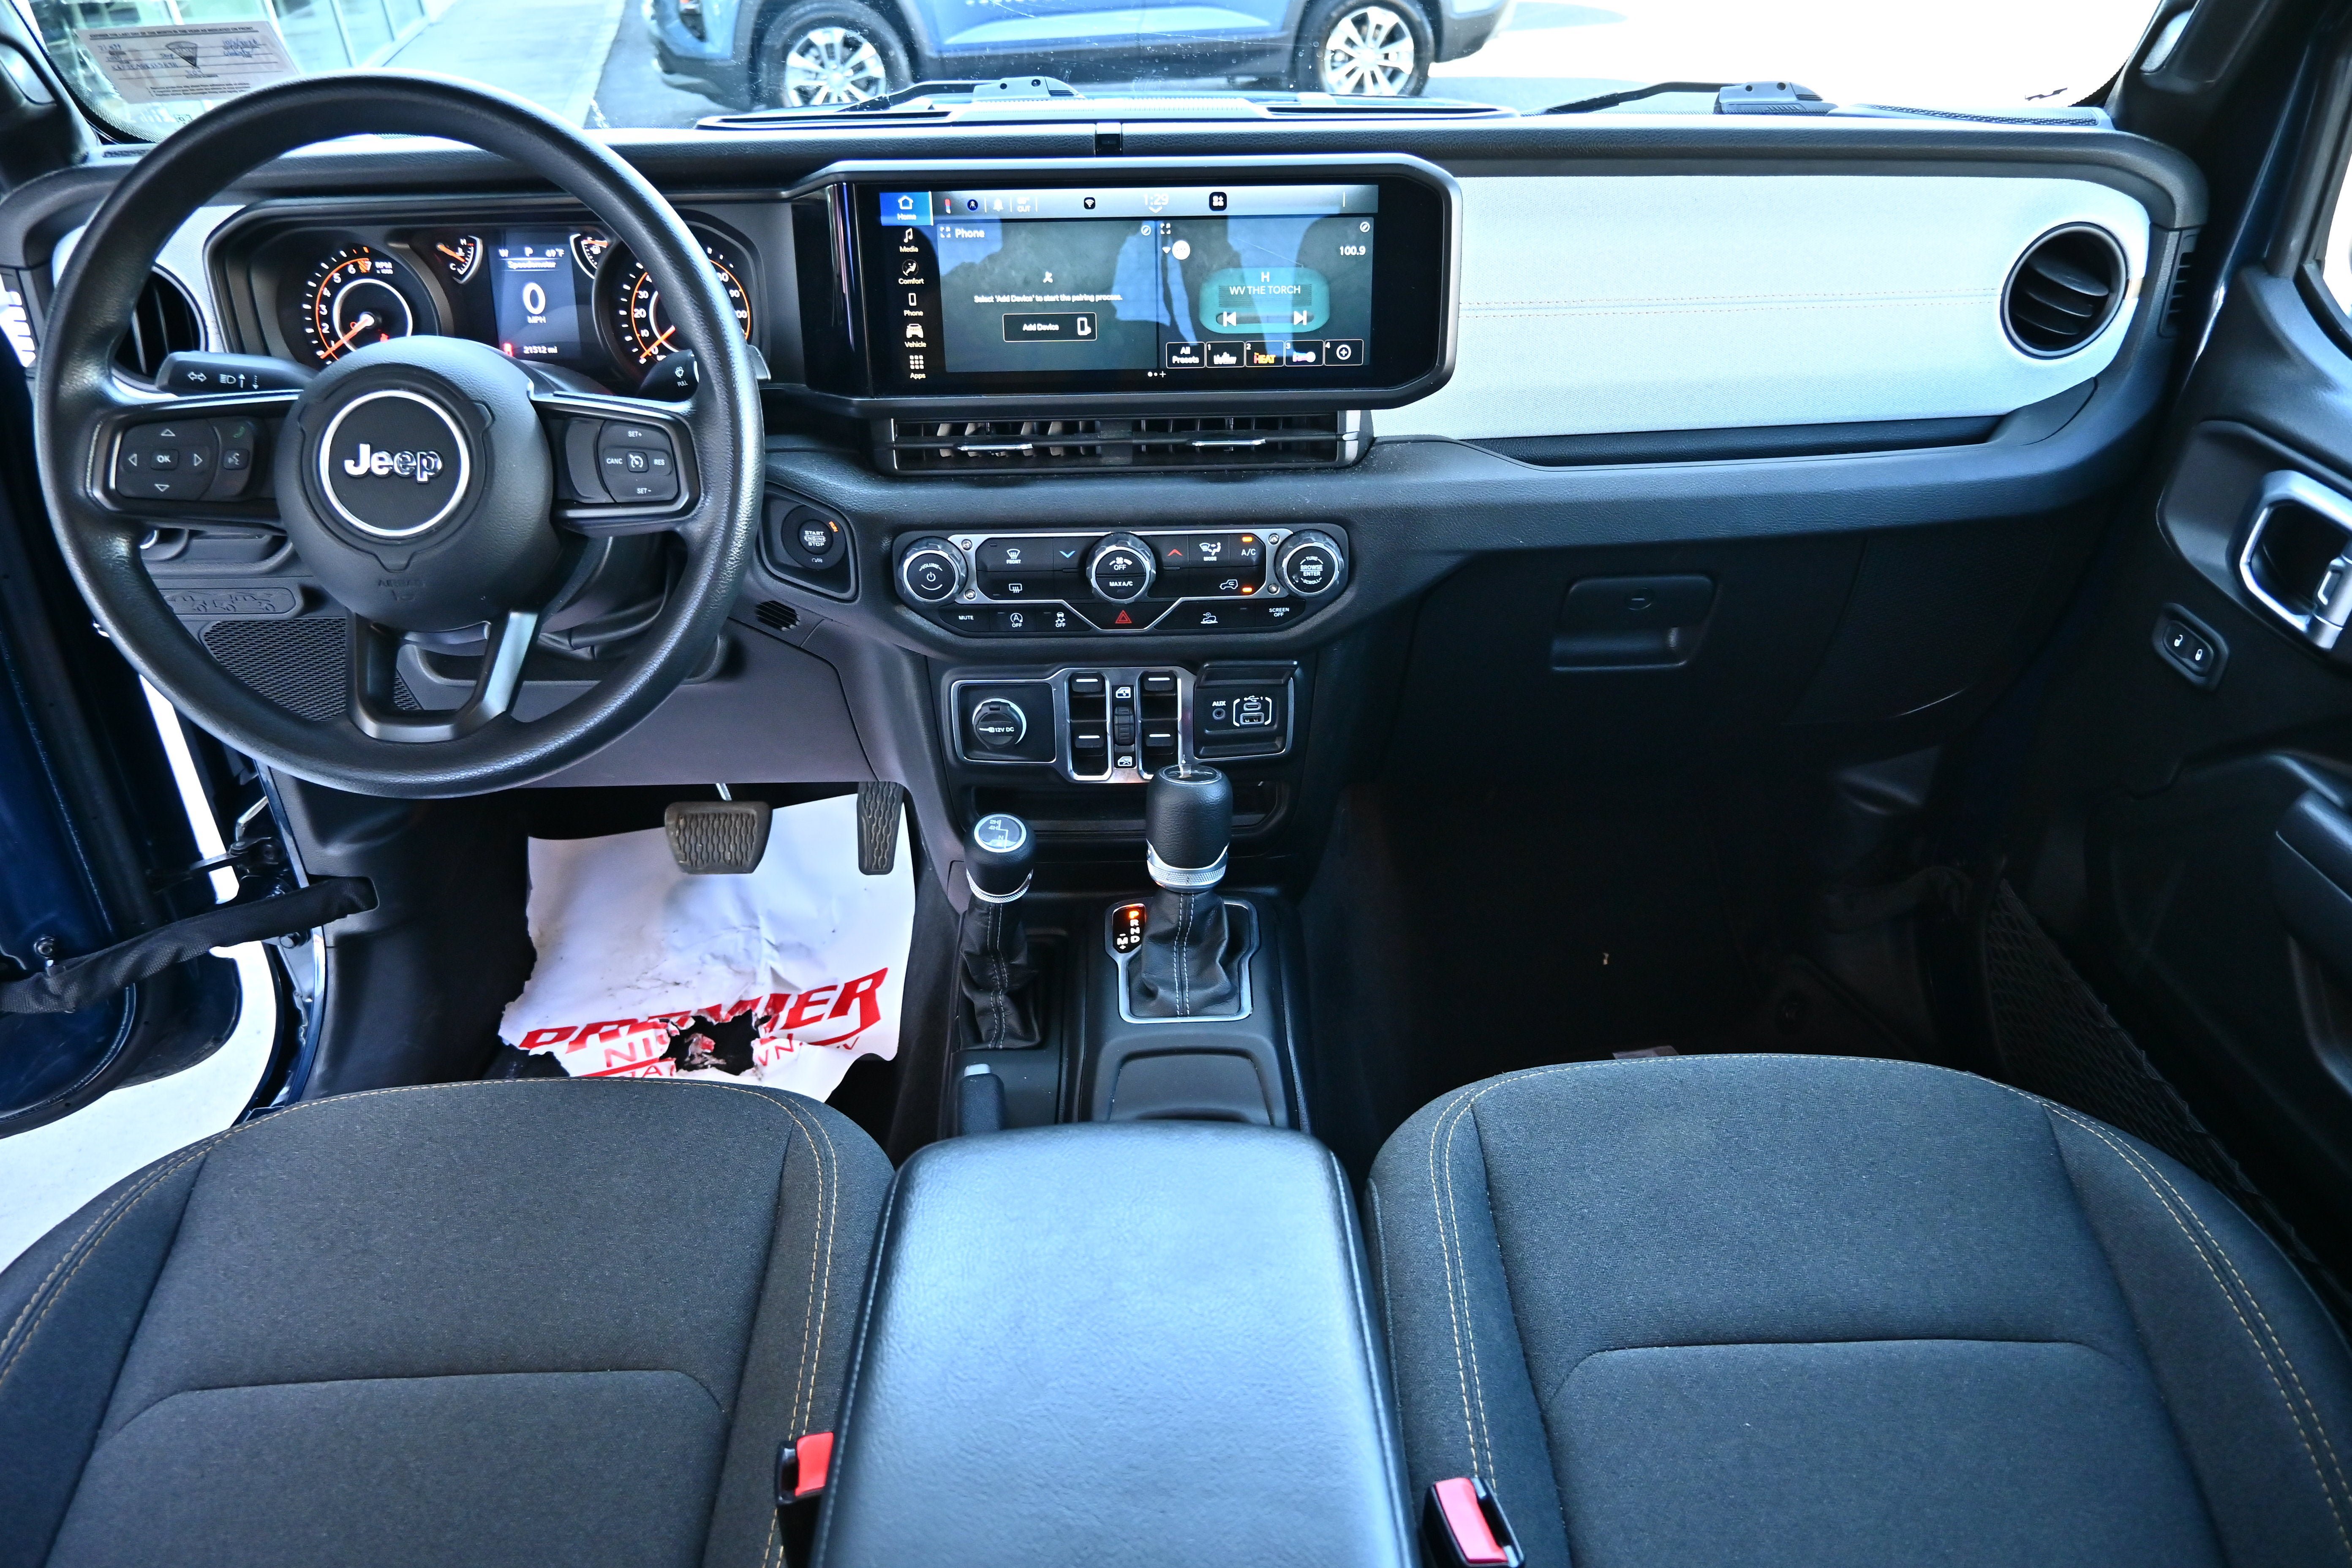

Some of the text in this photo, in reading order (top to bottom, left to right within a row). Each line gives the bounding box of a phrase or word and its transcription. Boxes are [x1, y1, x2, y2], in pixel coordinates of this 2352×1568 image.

[1144, 194, 1169, 205] 1:29
[955, 228, 985, 238] Phone
[1339, 245, 1366, 256] 100.9
[348, 264, 356, 274] 6
[333, 272, 341, 283] 5
[1261, 272, 1270, 282] H
[323, 287, 331, 297] 4
[729, 289, 740, 298] 90
[1229, 285, 1301, 295] WV THE TORCH
[523, 282, 546, 315] 0
[638, 291, 649, 299] 30
[1072, 294, 1094, 302] pairing
[319, 305, 328, 315] 3
[634, 308, 646, 318] 20
[321, 323, 330, 333] 2
[1037, 323, 1059, 331] Device
[640, 329, 650, 337] 10
[523, 346, 547, 354] 21512
[1180, 346, 1191, 354] All
[1172, 356, 1199, 364] Presets
[157, 455, 171, 463] OK
[344, 443, 444, 484] Jeep
[1241, 548, 1256, 556] A/C
[1129, 910, 1139, 919] P
[1130, 927, 1140, 935] N
[1117, 937, 1128, 945] M
[1130, 935, 1140, 943] D
